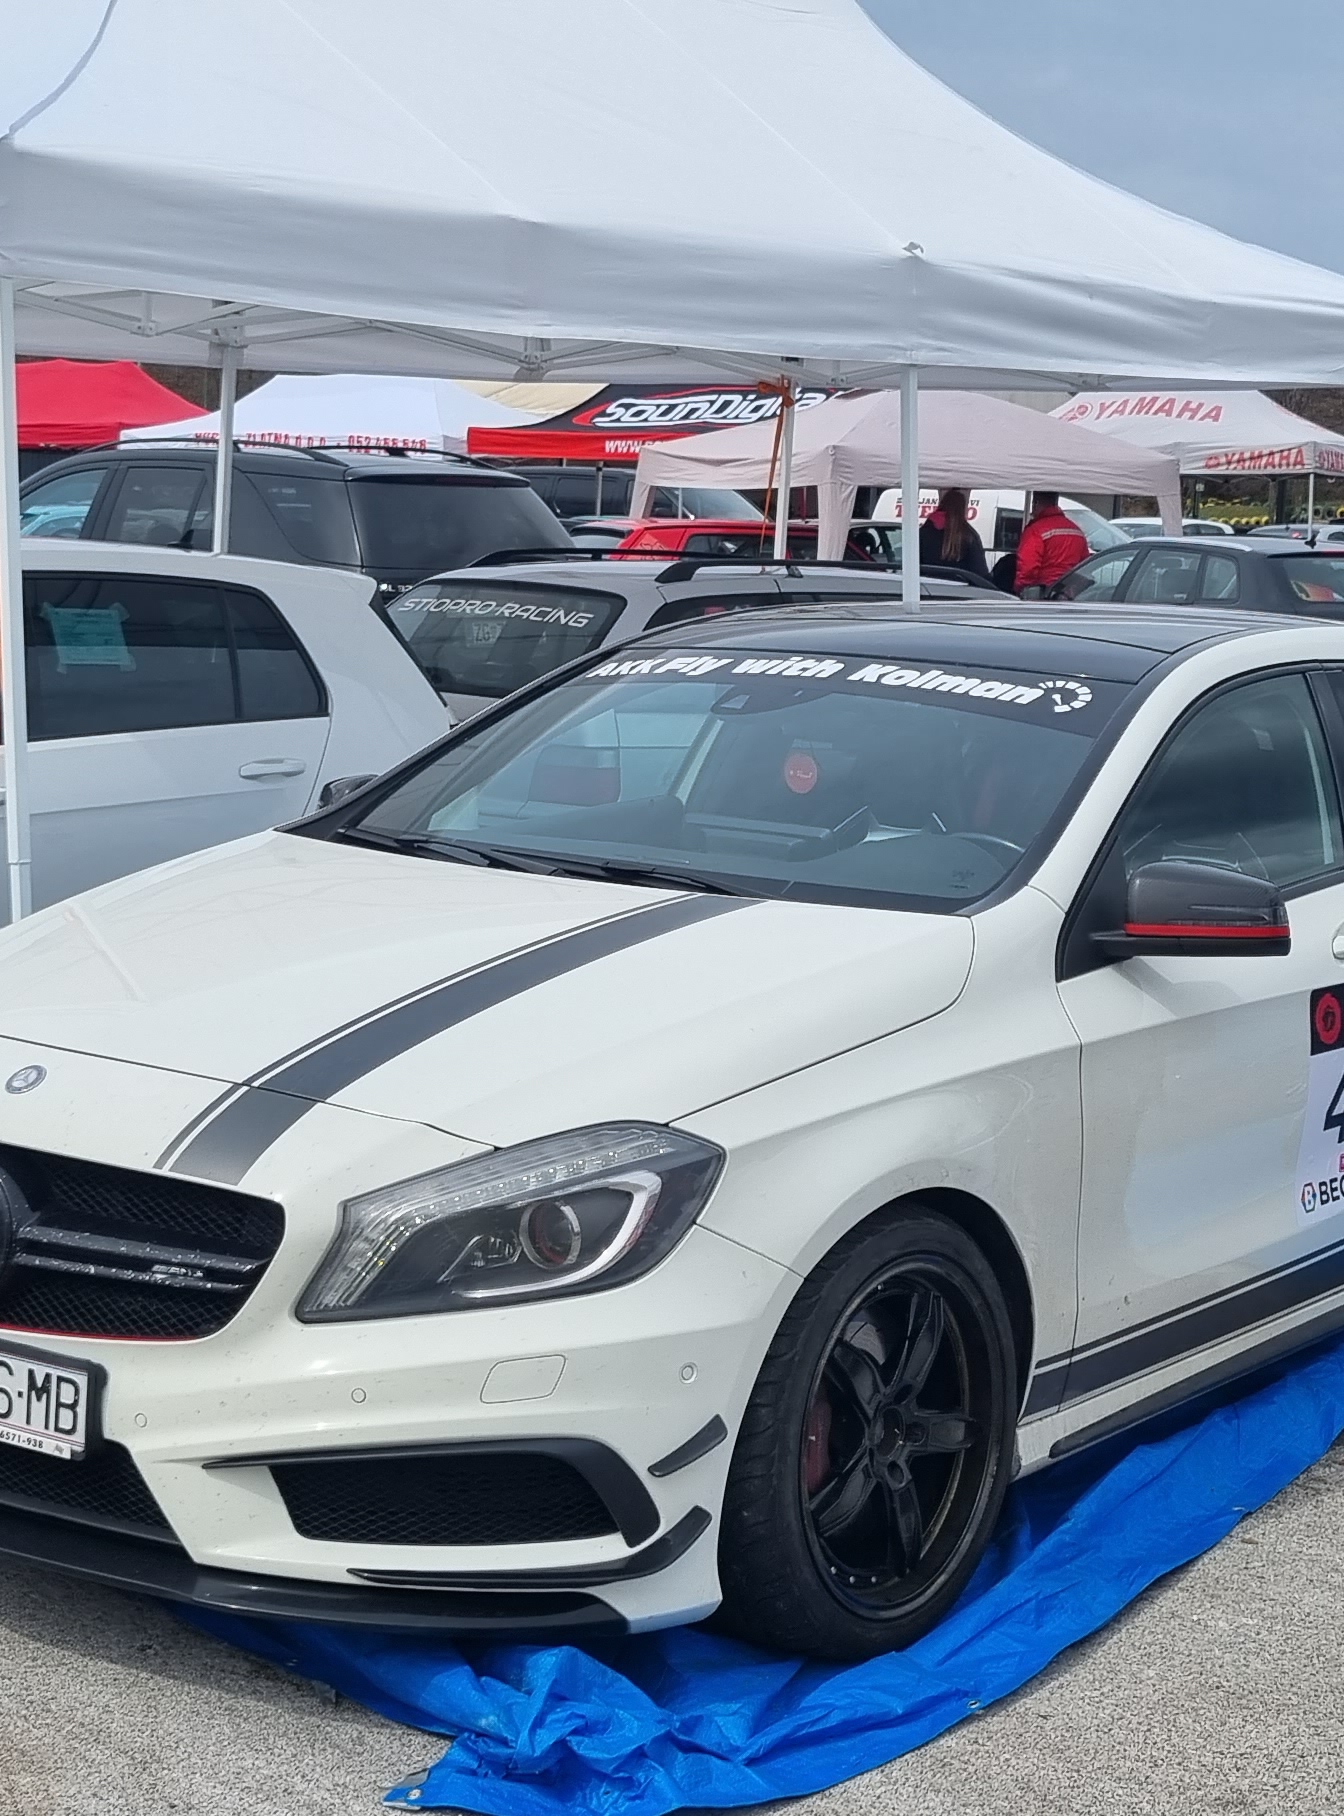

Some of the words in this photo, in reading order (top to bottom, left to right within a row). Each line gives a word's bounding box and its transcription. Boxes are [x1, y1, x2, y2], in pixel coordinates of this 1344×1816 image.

[596, 388, 847, 424] SounDigia
[1094, 396, 1224, 424] YAMAHA
[1225, 448, 1307, 471] YAMAHA
[584, 658, 667, 679] AKK
[654, 656, 736, 676] Fly
[731, 655, 846, 678] with
[847, 663, 1046, 705] Kolman
